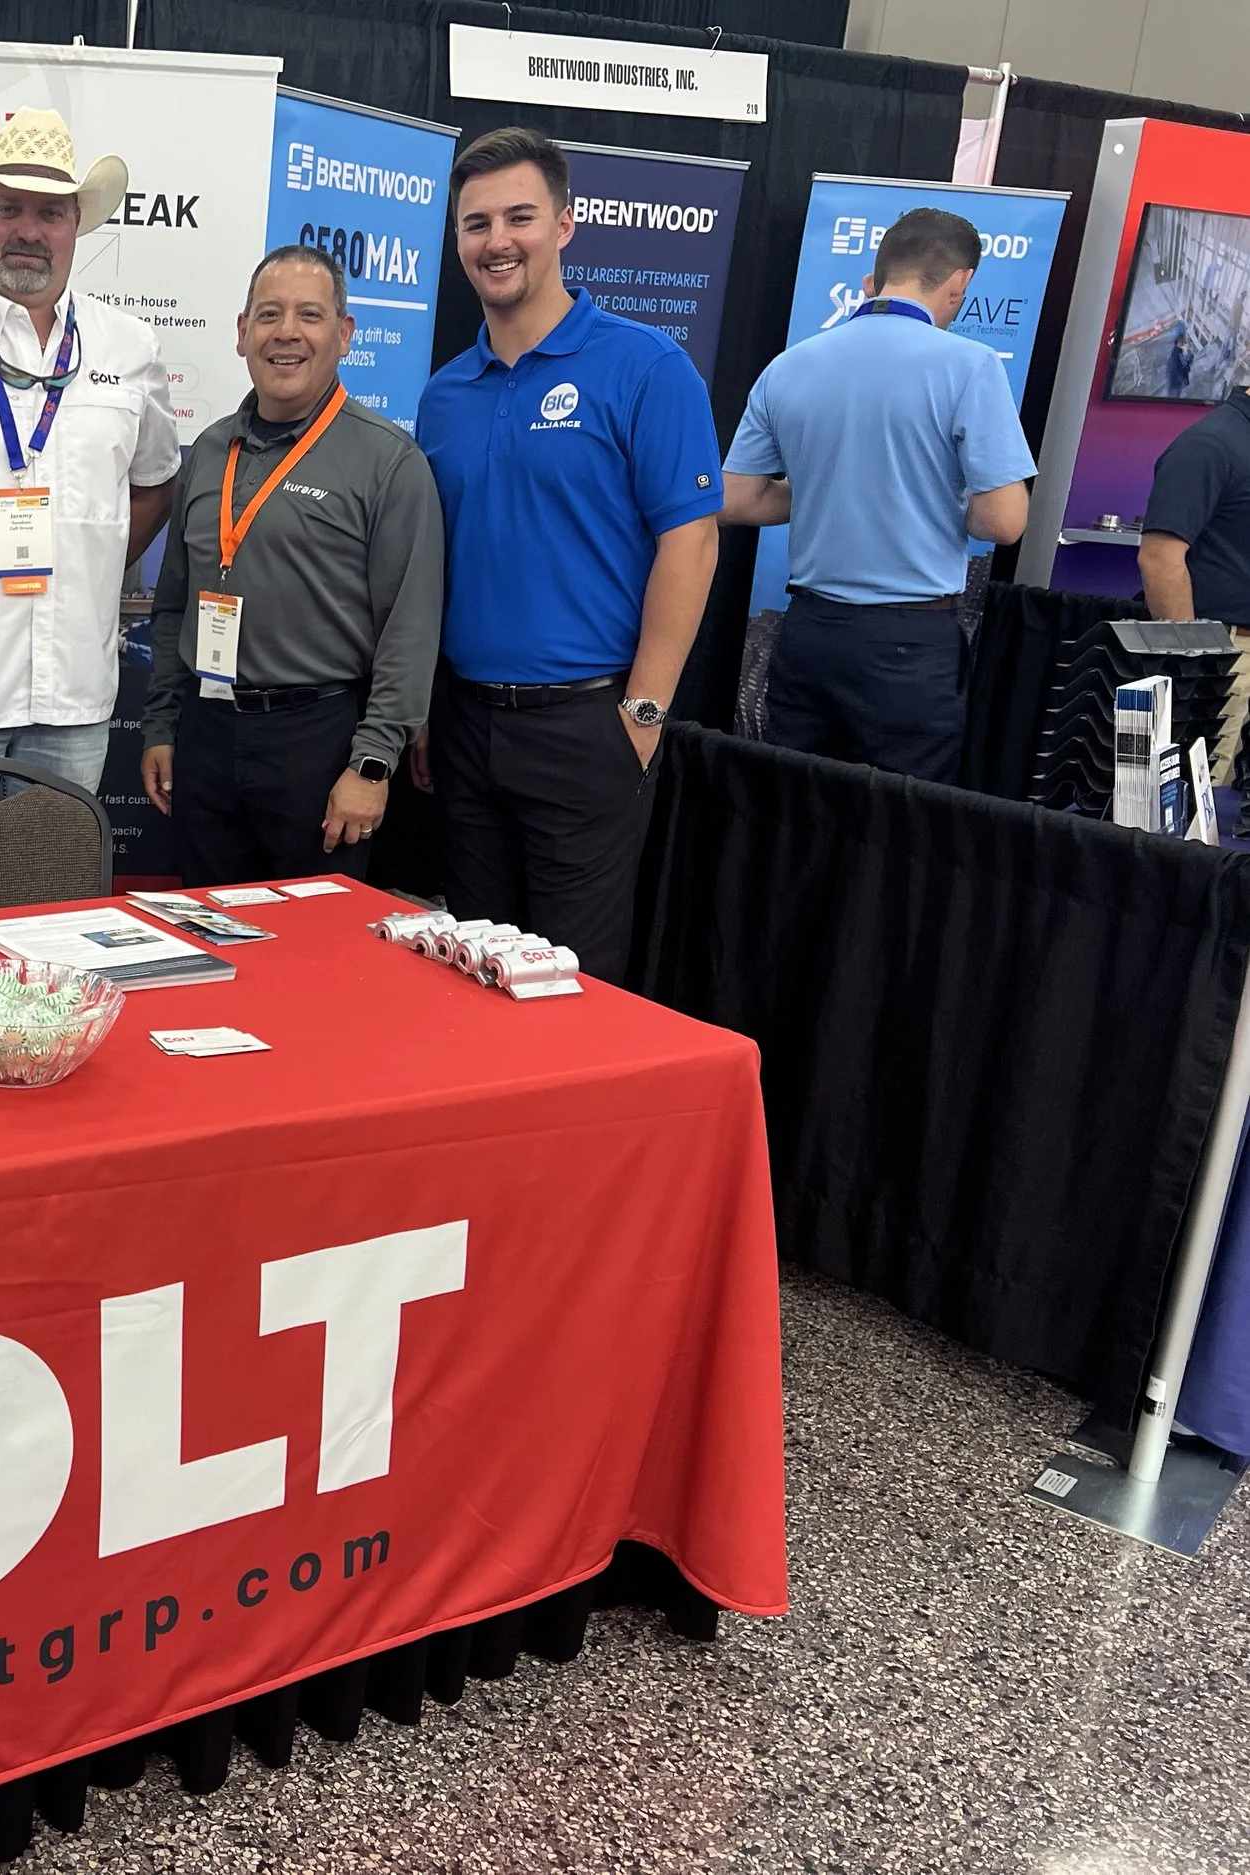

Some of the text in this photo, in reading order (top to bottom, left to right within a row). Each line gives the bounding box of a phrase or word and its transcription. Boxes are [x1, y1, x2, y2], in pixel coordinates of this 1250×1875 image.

[528, 56, 698, 92] BRENTWOOD INDUSTRIES, INC.
[746, 103, 758, 115] 219
[103, 192, 200, 229] EAK
[586, 266, 710, 288] LARGEST AFTERMARKET
[124, 294, 177, 308] in-house
[595, 294, 697, 315] OF COOLING TOWER
[154, 314, 206, 328] between
[364, 327, 401, 344] drift loss
[977, 324, 1018, 338] Technology
[89, 371, 121, 385] COLT
[543, 392, 577, 412] BIC
[529, 419, 581, 431] ALLIANCE
[282, 480, 329, 500] kuraray
[521, 950, 558, 963] COLT
